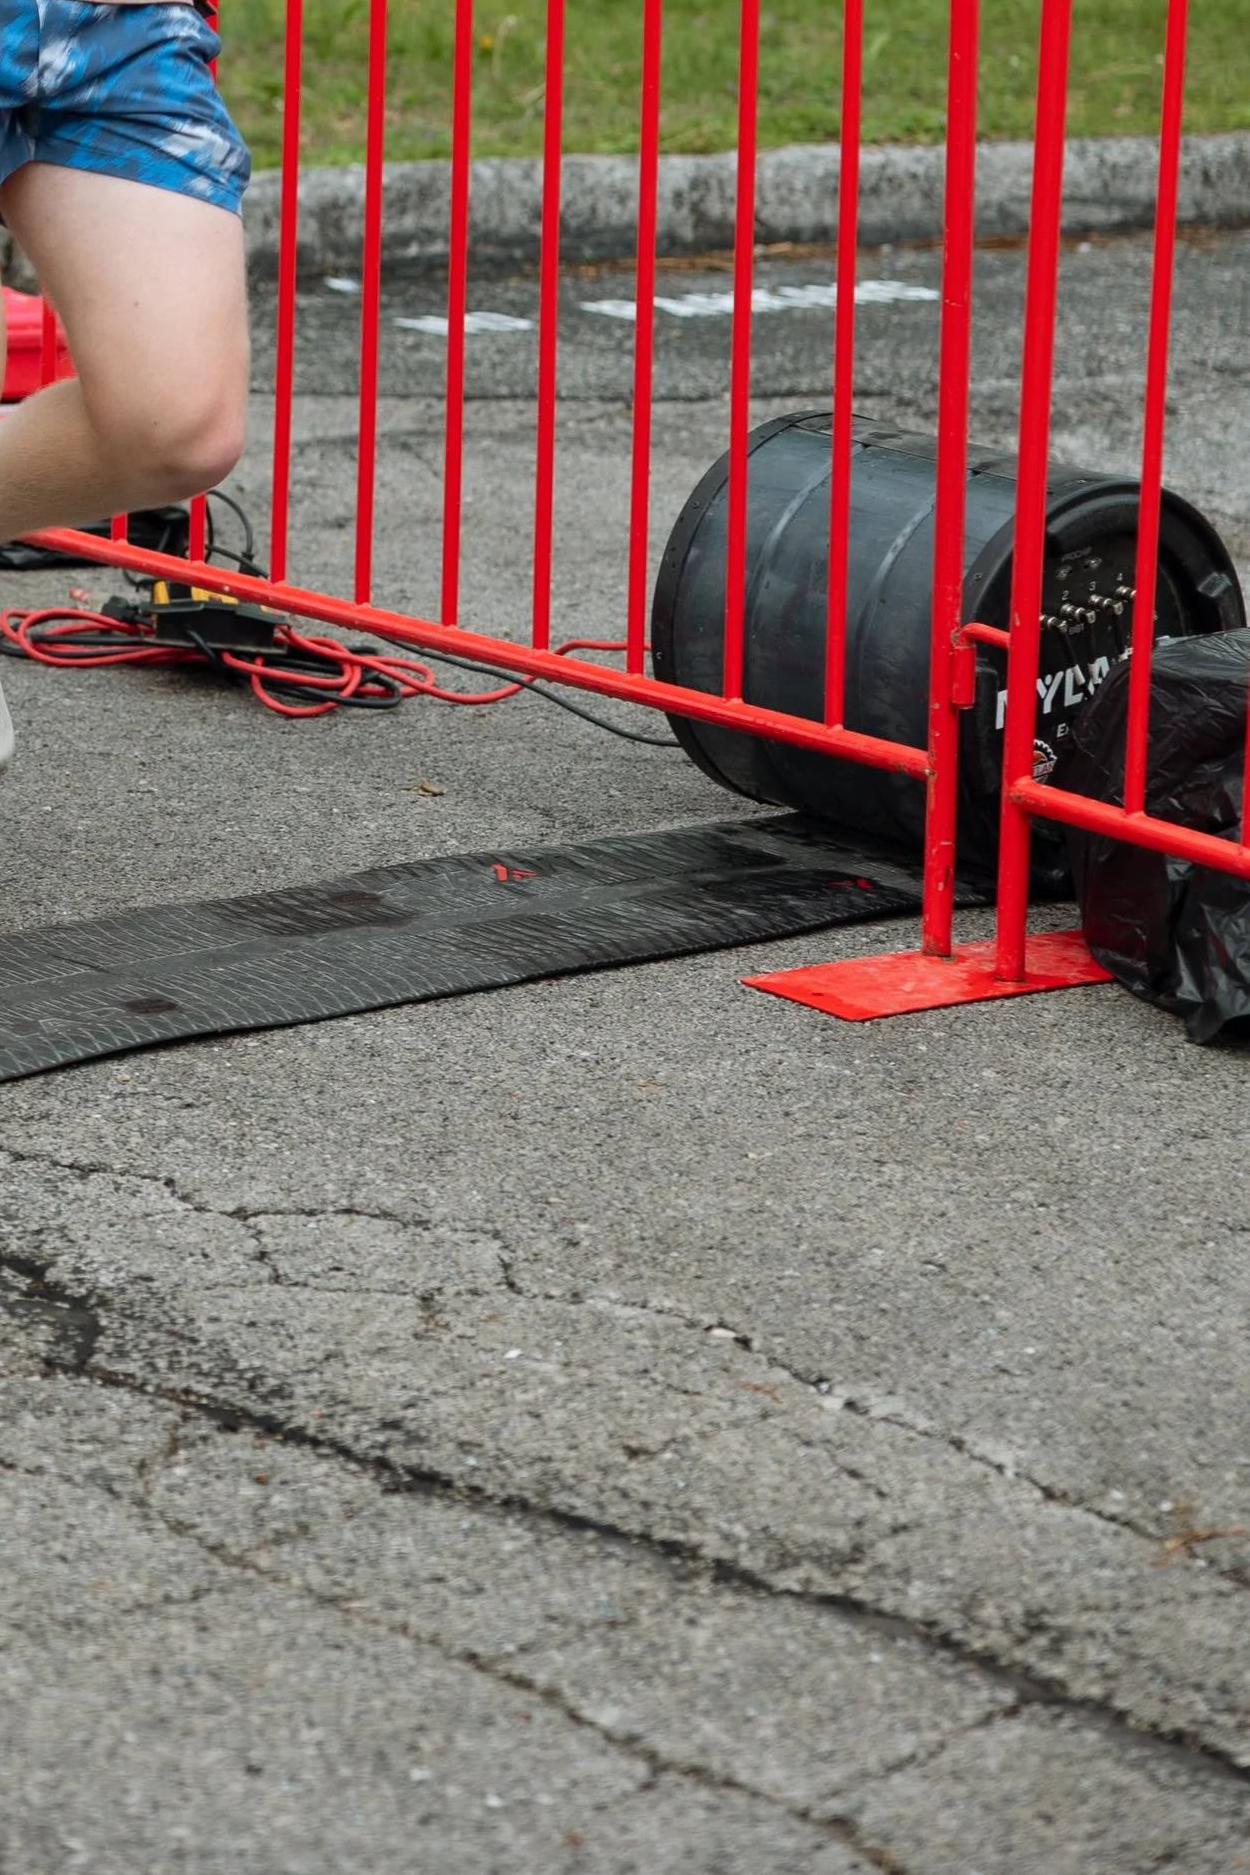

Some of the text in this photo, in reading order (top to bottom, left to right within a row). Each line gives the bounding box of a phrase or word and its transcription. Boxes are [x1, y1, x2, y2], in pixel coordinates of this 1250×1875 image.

[1061, 572, 1123, 601] 2 3 4
